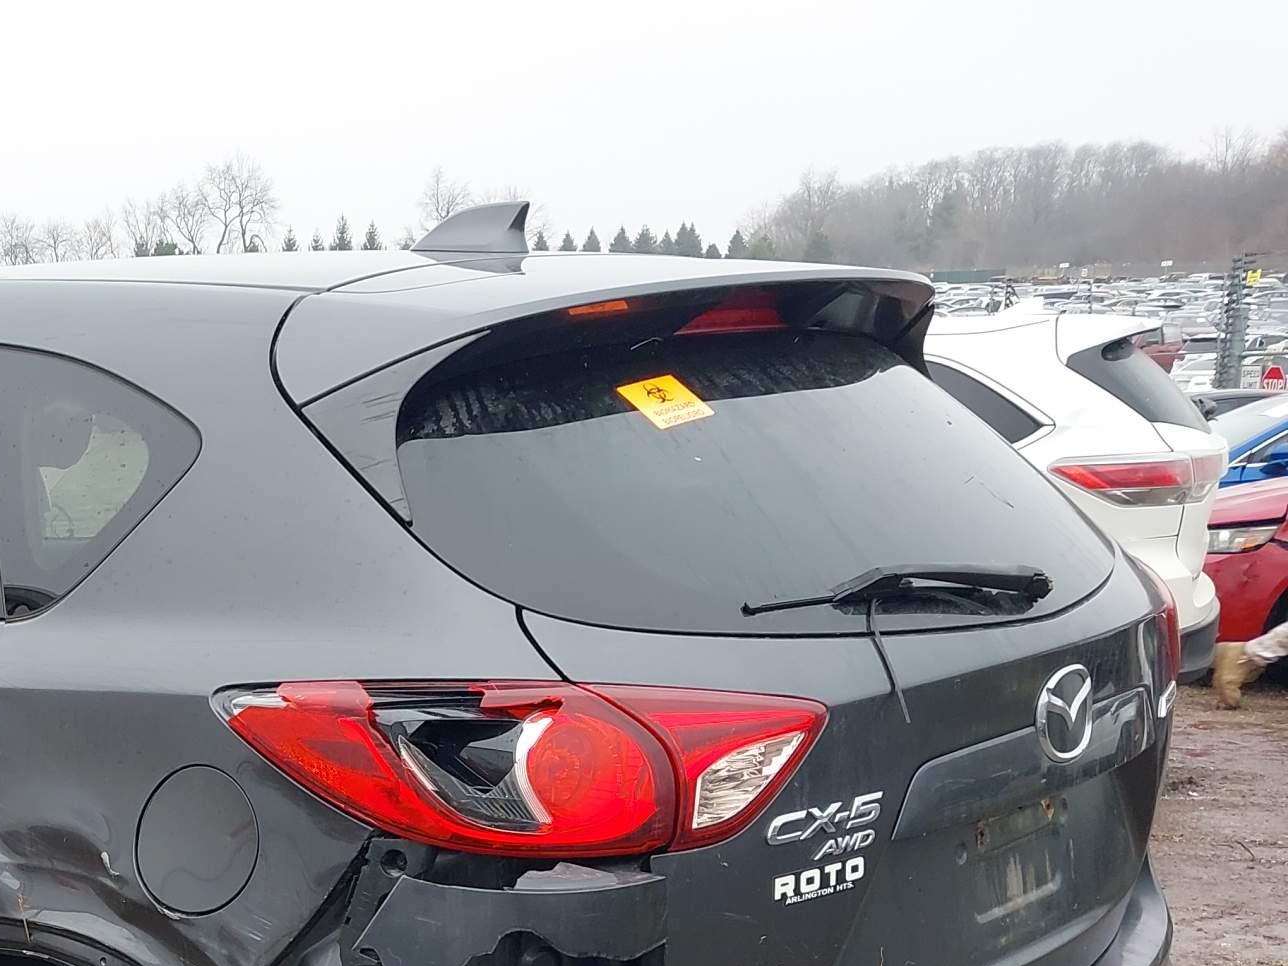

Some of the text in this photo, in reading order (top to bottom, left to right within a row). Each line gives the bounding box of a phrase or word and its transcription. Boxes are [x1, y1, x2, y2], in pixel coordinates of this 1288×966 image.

[1263, 379, 1283, 390] STOP
[767, 791, 884, 845] CX-5
[812, 829, 876, 861] AWD
[774, 856, 865, 901] ROTO
[785, 886, 834, 905] ARLINGTON
